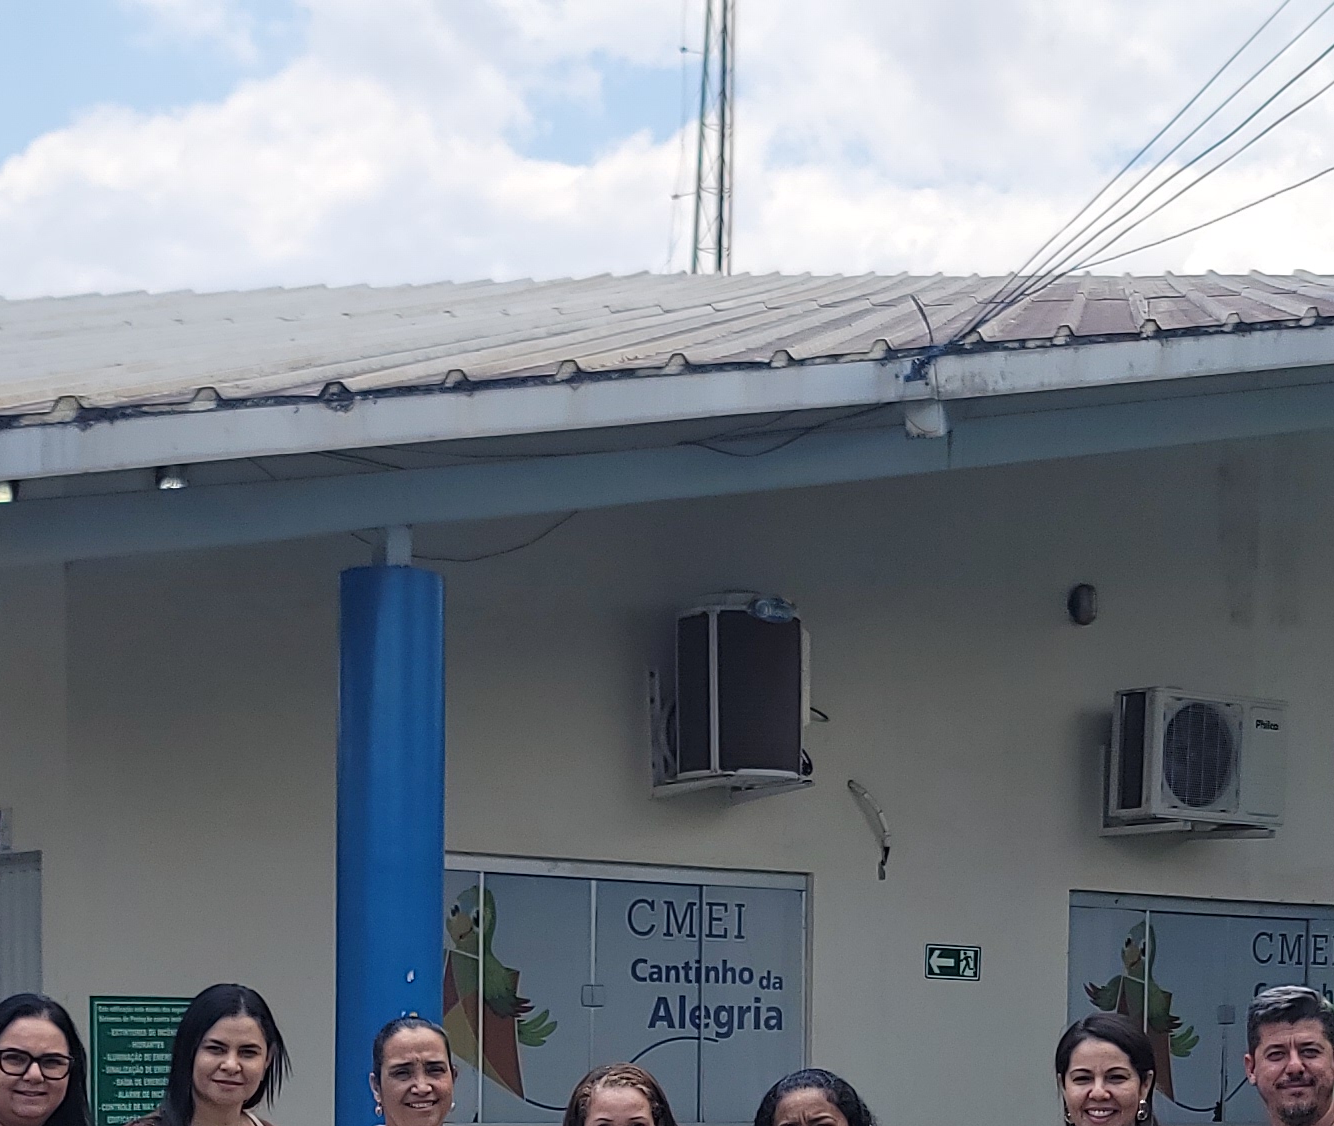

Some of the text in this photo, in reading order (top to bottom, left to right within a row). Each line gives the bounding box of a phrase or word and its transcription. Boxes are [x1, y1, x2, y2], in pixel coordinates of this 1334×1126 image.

[1255, 719, 1279, 730] Philco
[627, 899, 746, 939] CMEI
[631, 958, 784, 990] Cantinho da
[647, 995, 783, 1038] Alegria
